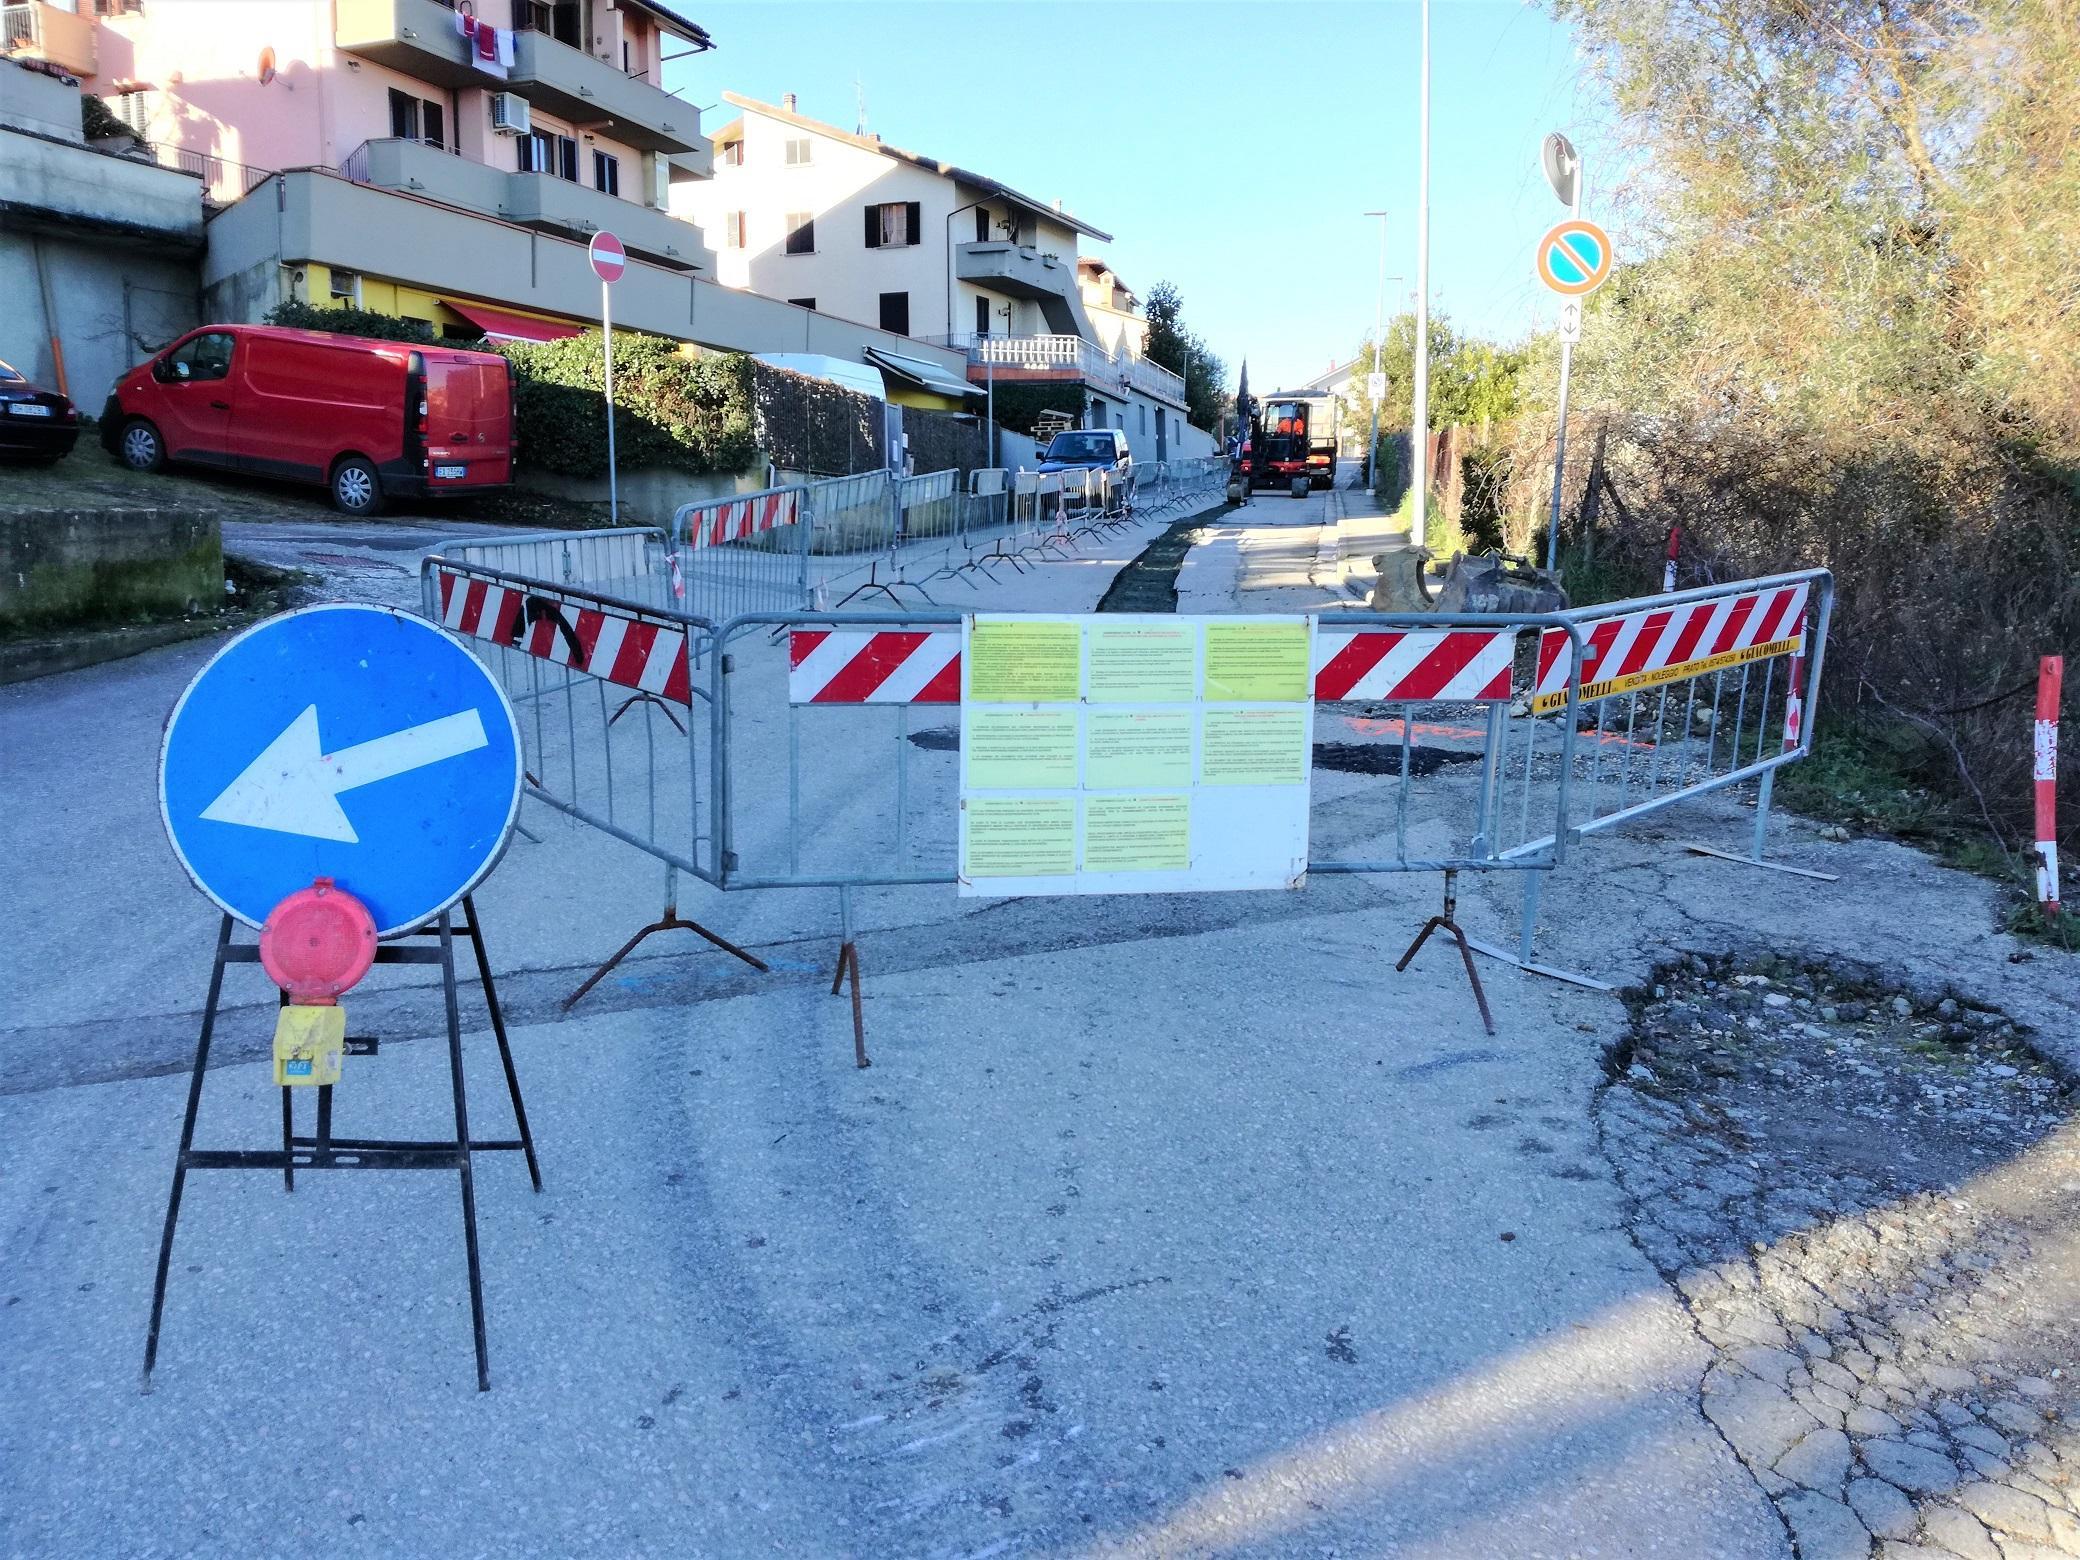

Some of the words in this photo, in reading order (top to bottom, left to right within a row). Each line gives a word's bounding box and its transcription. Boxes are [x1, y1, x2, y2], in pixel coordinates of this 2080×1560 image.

[1550, 681, 1612, 707] GIAMELLI
[1625, 674, 1647, 687] VENDITA
[1652, 668, 1679, 681] NOLEGGIO
[1683, 662, 1700, 673] PRATO
[1746, 640, 1790, 659] GIACOMELLI
